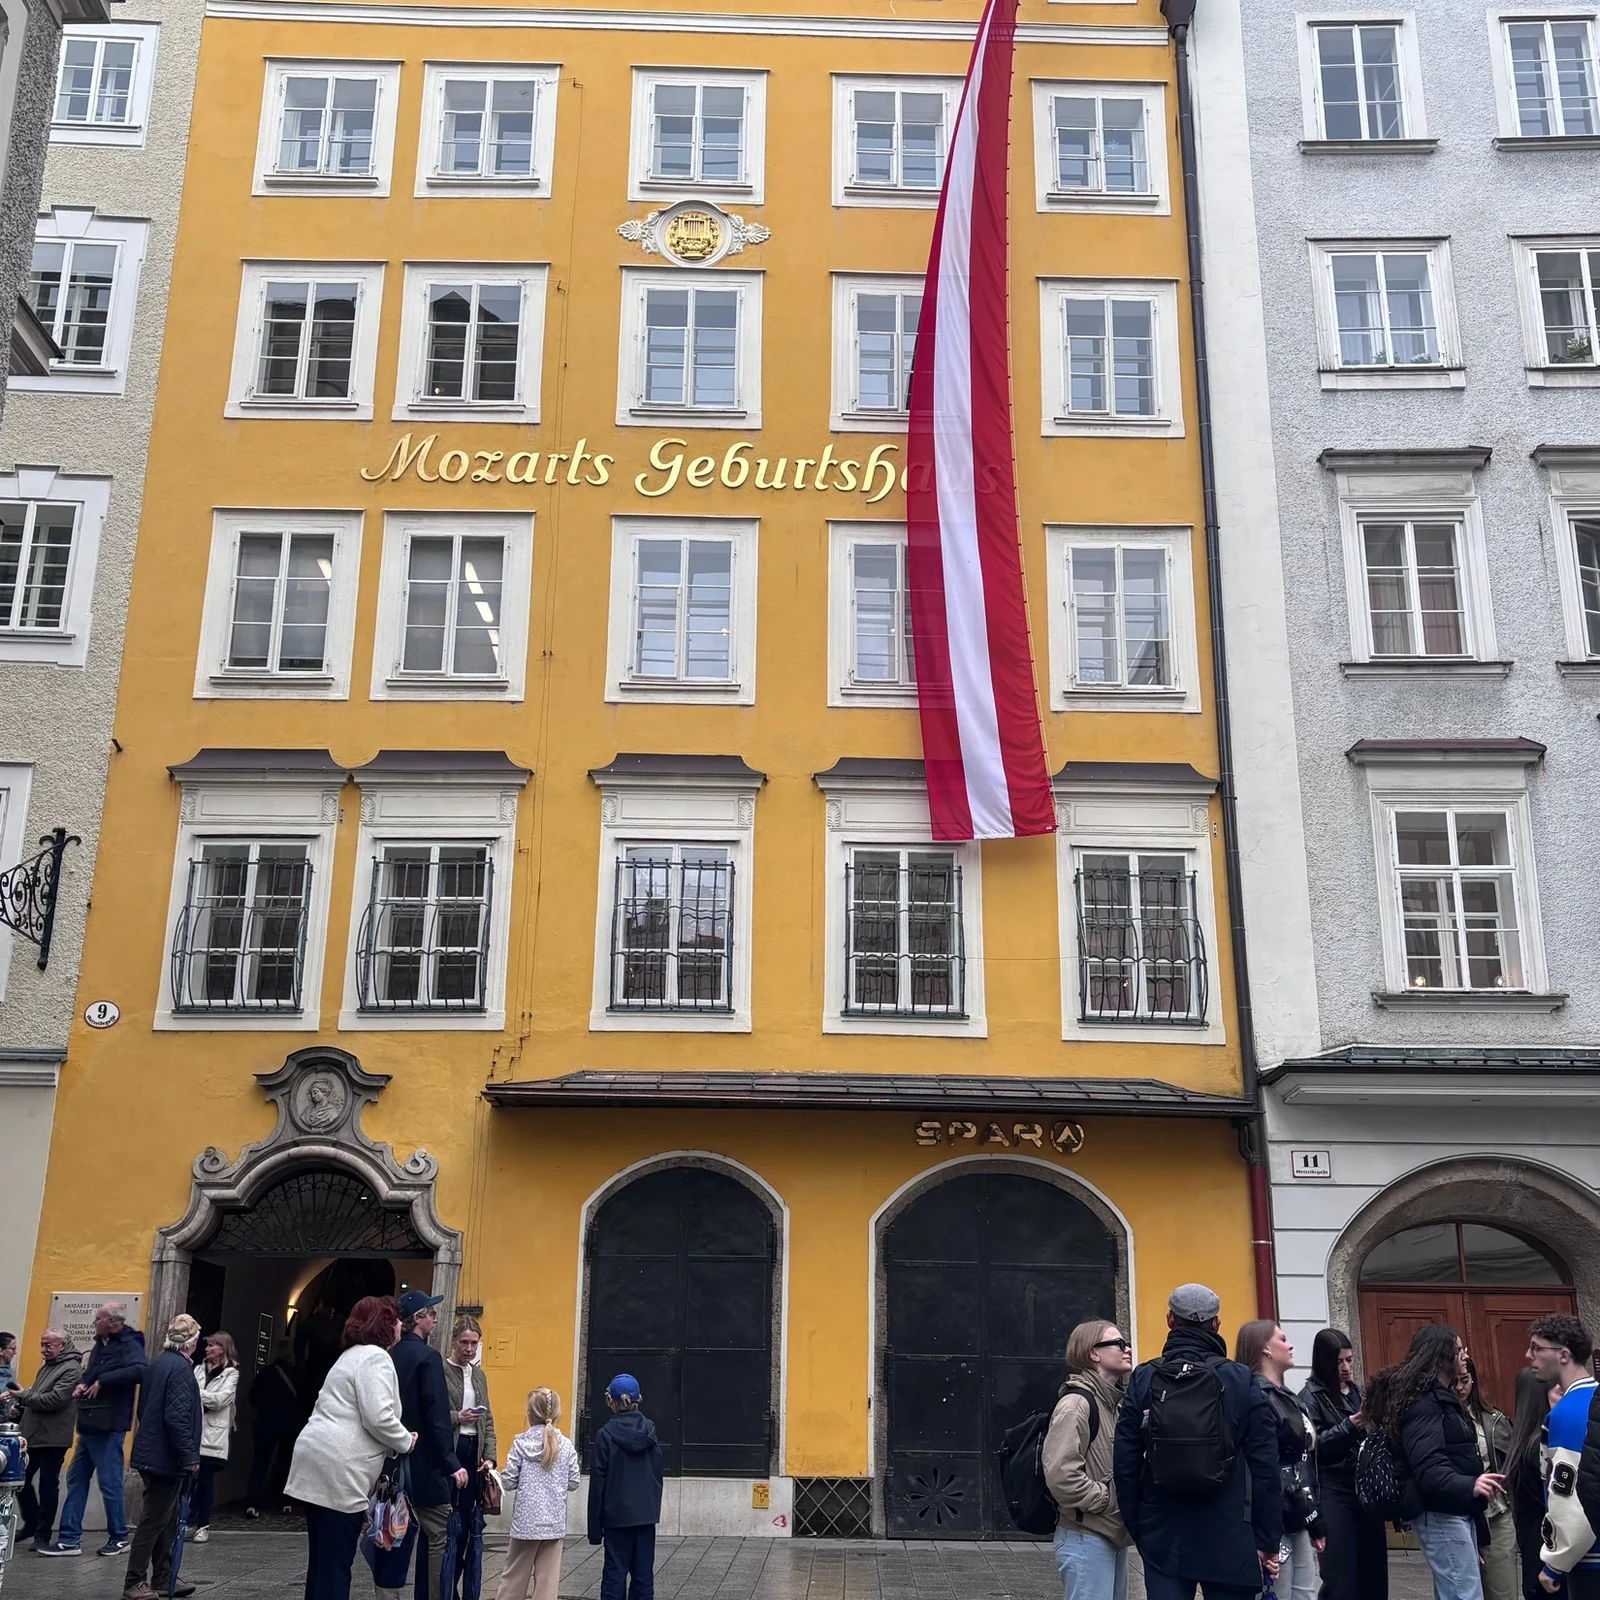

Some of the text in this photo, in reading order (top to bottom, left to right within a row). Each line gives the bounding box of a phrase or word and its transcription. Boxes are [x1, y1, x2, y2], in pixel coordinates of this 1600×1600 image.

[359, 432, 1002, 504] Mozarts Geburtshas
[97, 1003, 108, 1020] 9
[915, 1121, 1044, 1149] SPAR
[1300, 1154, 1320, 1168] 11
